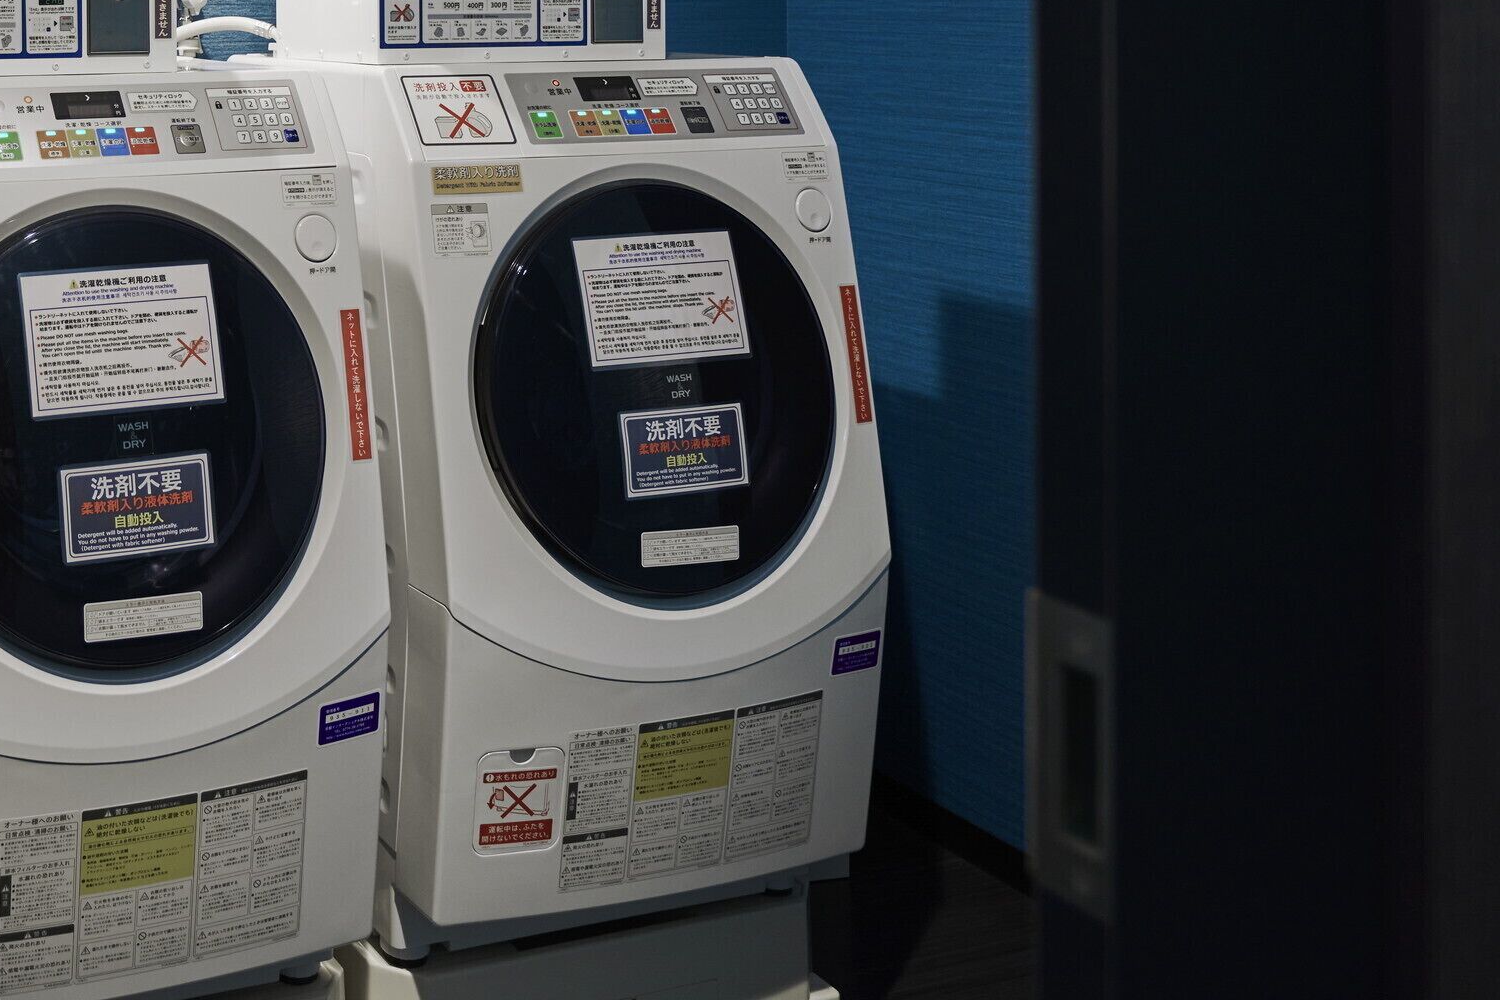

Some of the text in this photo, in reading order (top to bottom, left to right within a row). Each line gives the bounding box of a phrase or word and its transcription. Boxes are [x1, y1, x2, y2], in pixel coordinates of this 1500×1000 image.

[413, 81, 485, 93] 洗剤投入 不要
[547, 88, 572, 96] 営業中
[16, 105, 45, 114] 営業中
[434, 165, 520, 180] 柔軟剤入り洗剤
[457, 205, 472, 213] 注意
[623, 239, 695, 252] 洗濯乾燥機ご利用の注意
[79, 274, 167, 288] 洗濯乾燥機ご利用の注意
[347, 312, 366, 457] ネットに入れて洗濯しないで下さい
[666, 373, 692, 383] WASH
[671, 390, 691, 399] DRY
[118, 421, 149, 432] WASH
[646, 415, 721, 442] 洗剤不要
[123, 439, 147, 450] DRY
[637, 435, 731, 456] 柔軟剤入り液体洗剤
[666, 453, 708, 467] 自動投入
[91, 468, 182, 500] 洗剤不要
[81, 490, 193, 516] 柔軟剤入り液体洗剤
[114, 511, 164, 529] 自動投入
[495, 770, 555, 782] 水もれの恐れあり
